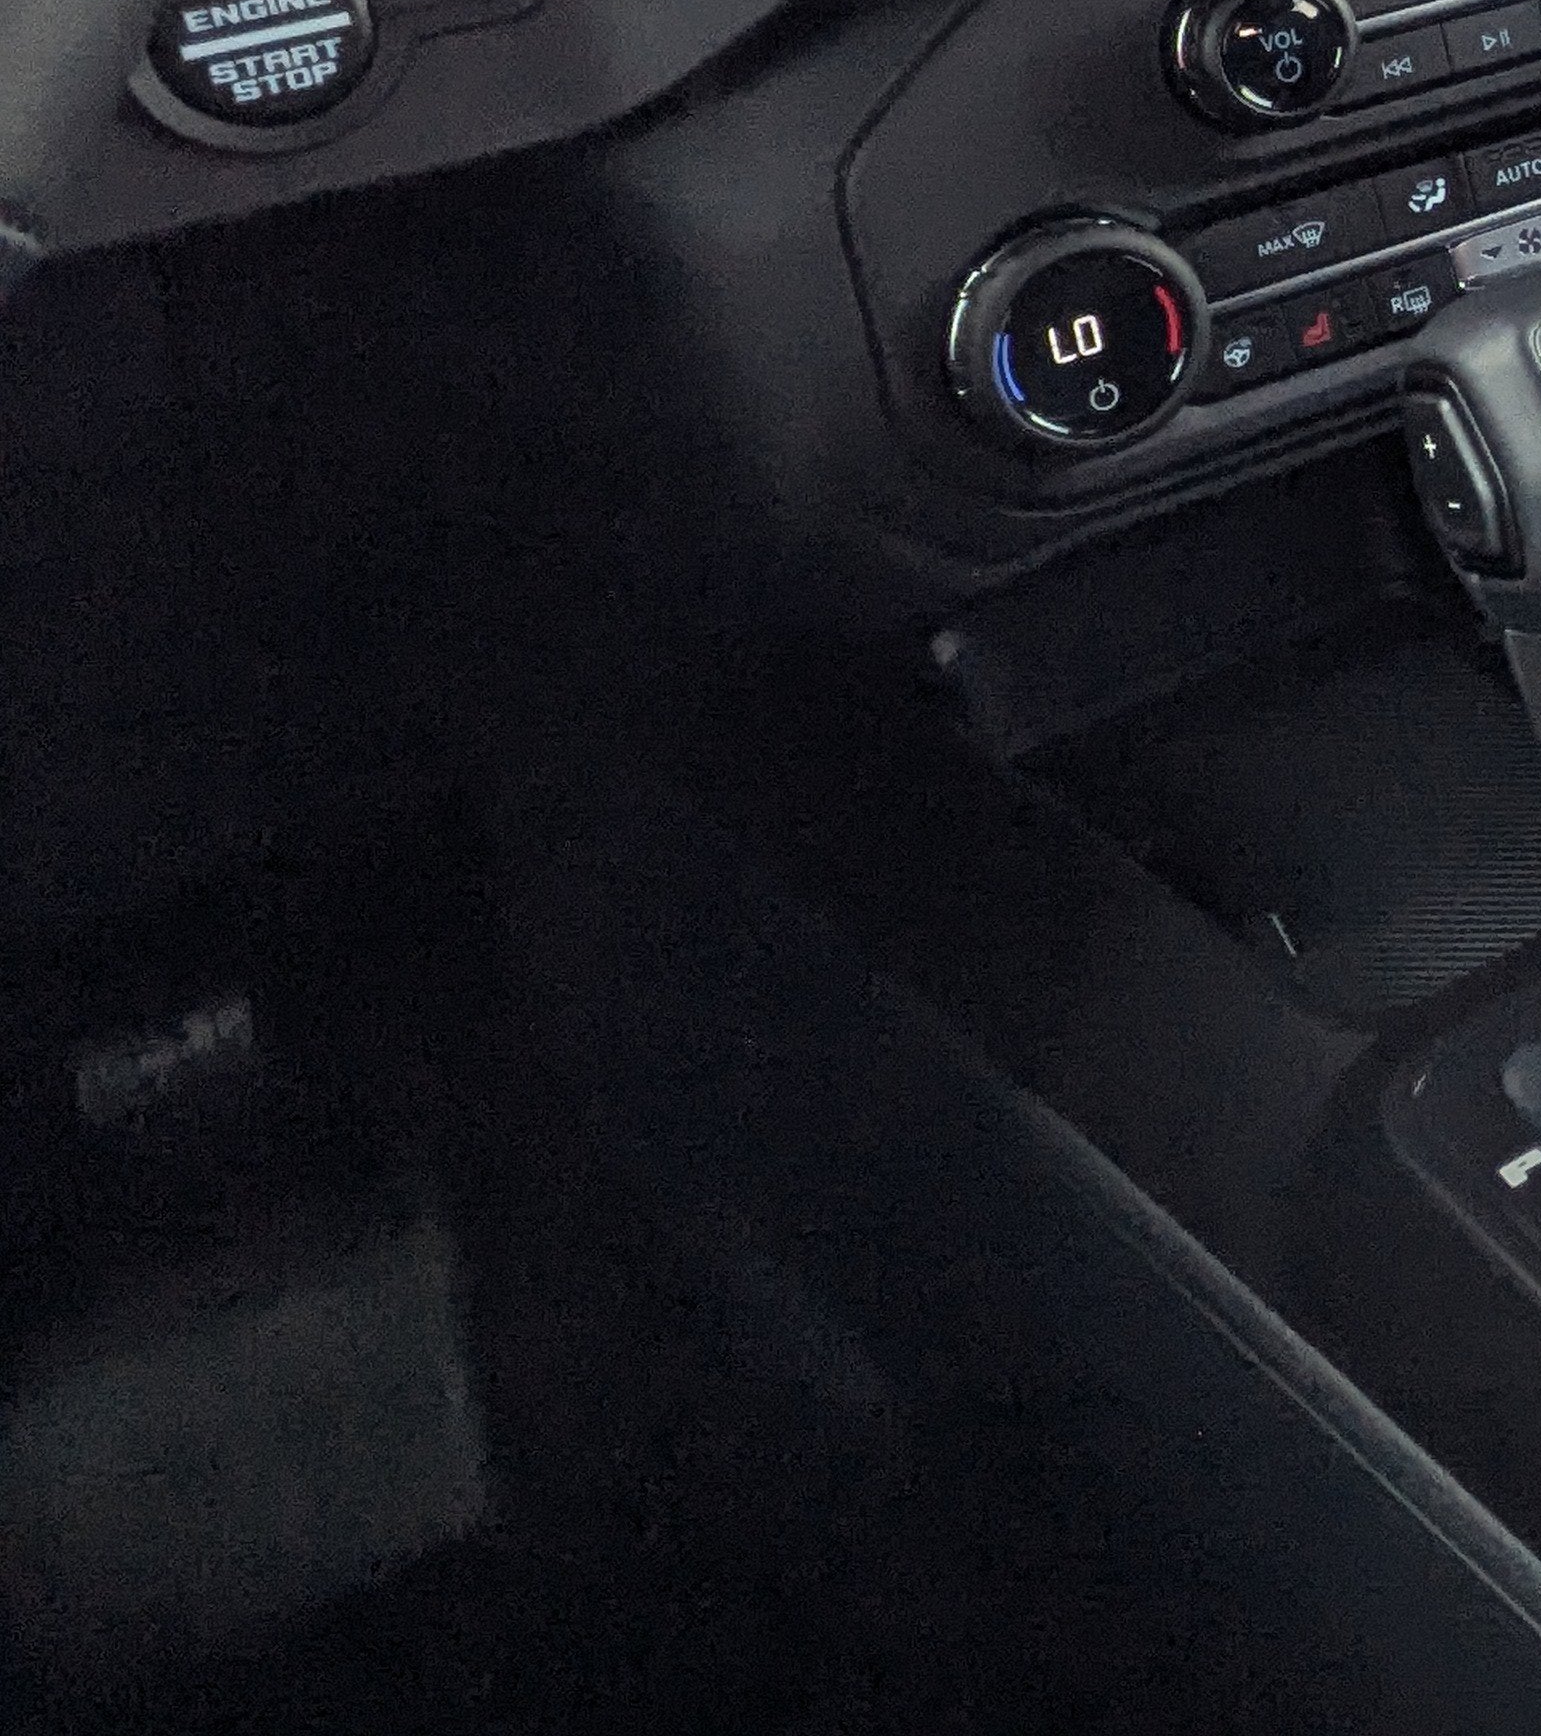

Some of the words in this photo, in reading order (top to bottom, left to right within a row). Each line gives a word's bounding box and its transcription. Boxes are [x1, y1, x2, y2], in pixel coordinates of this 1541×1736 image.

[210, 36, 343, 86] START
[1259, 31, 1303, 52] VOL
[233, 63, 338, 104] STOP
[1257, 235, 1295, 257] MAX
[1047, 314, 1103, 365] LO
